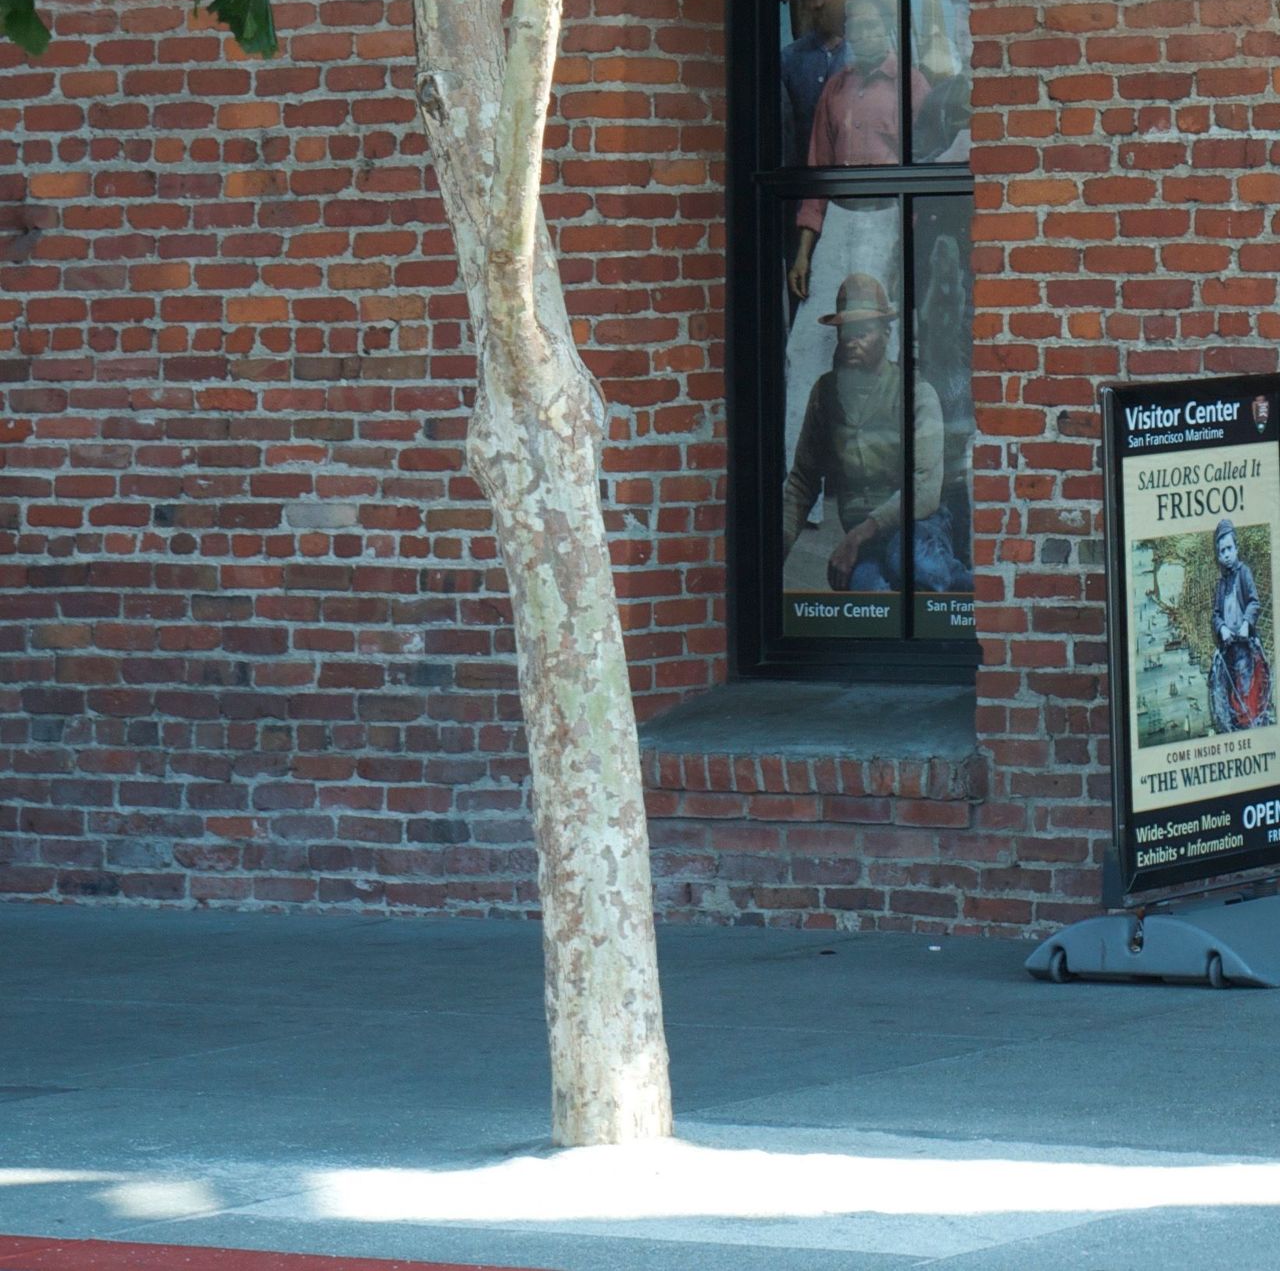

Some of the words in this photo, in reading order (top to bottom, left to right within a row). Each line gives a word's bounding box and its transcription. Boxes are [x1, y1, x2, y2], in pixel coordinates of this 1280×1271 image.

[1125, 403, 1181, 431] Visitor
[1185, 399, 1241, 425] Center
[1127, 434, 1144, 449] San
[1145, 431, 1184, 446] Francisco
[1185, 426, 1224, 441] Maritime
[1137, 464, 1200, 491] SAILORS
[1203, 459, 1248, 483] Called
[1250, 458, 1262, 478] It
[1156, 484, 1245, 521] FRISCO!
[794, 602, 839, 618] Visitor
[843, 602, 890, 618] Center
[926, 599, 947, 612] San
[1166, 749, 1191, 764] COME
[1194, 744, 1222, 759] INSIDE
[1224, 741, 1235, 753] TO
[1238, 738, 1253, 751] SEE
[1136, 818, 1200, 843] Wide-Screen
[1201, 810, 1232, 829] Movie
[1136, 845, 1178, 867] Exhibits
[1187, 833, 1244, 857] Information
